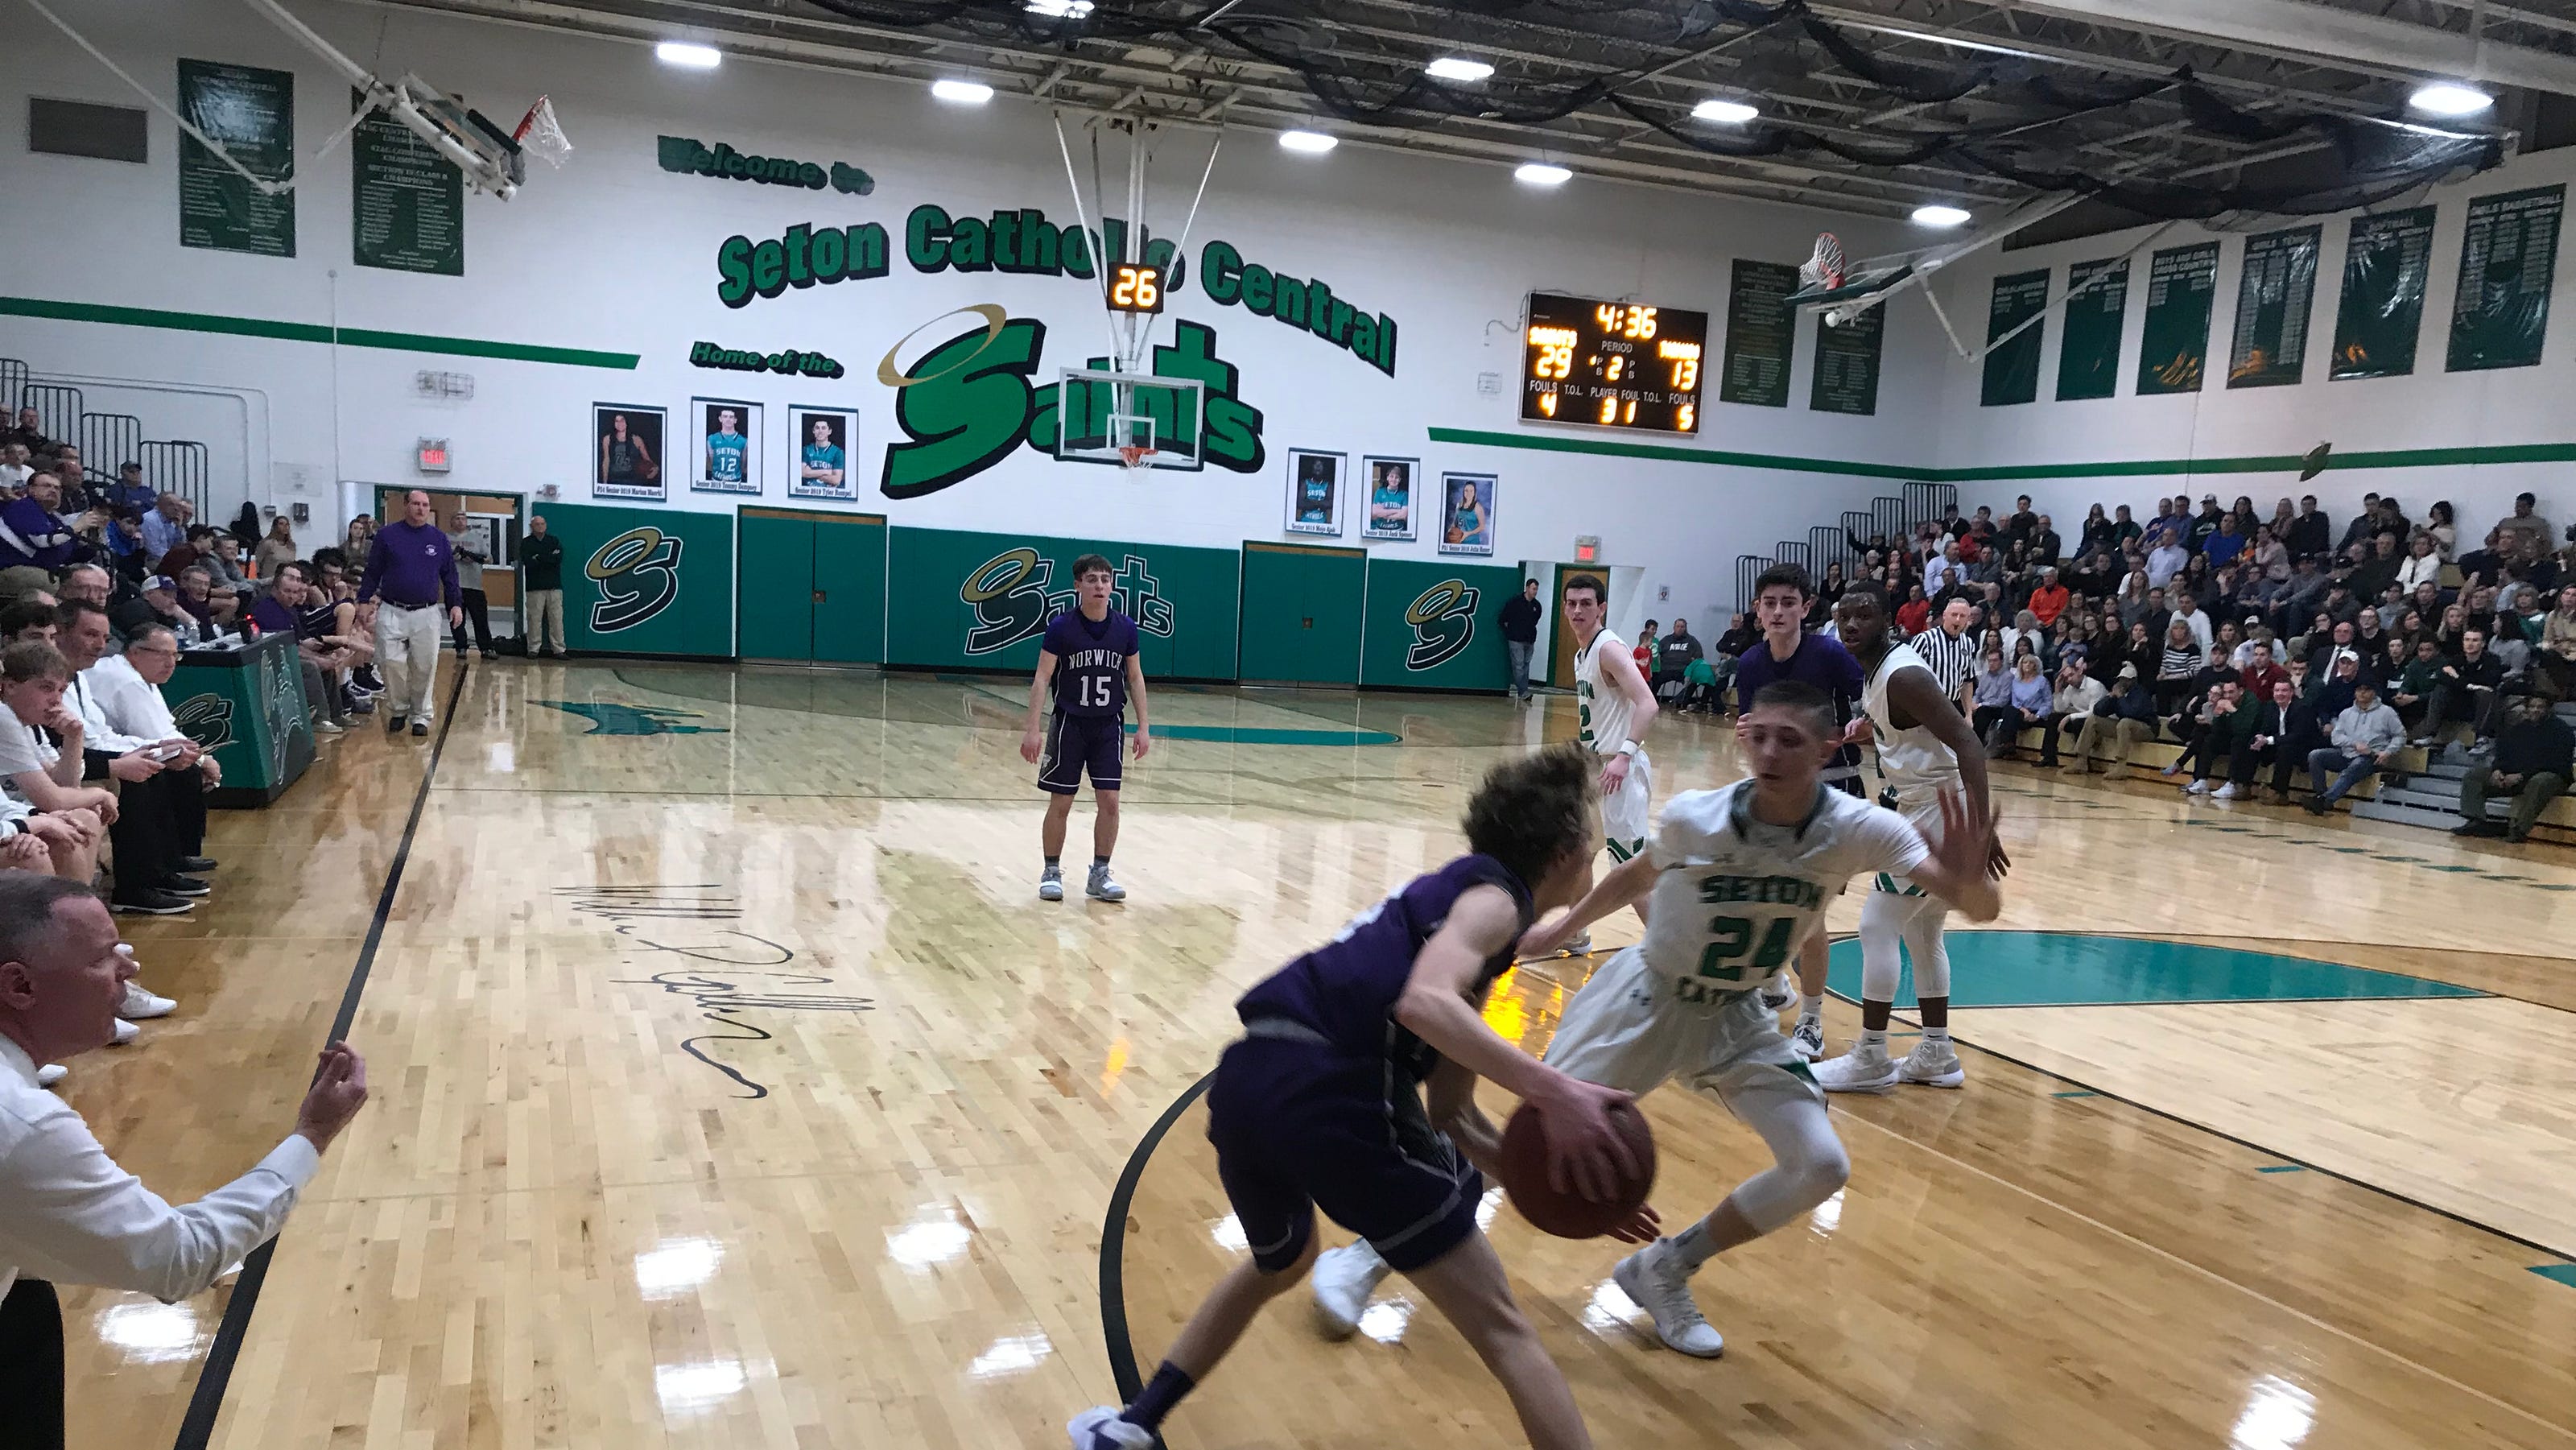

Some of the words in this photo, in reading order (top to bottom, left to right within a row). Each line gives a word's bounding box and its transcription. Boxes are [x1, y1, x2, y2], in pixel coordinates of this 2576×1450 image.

[658, 135, 828, 190] Welcome
[718, 222, 890, 308] Seton
[1200, 240, 1397, 378] Central
[1114, 267, 1158, 307] 26
[1597, 304, 1657, 338] 4:36
[689, 341, 768, 373] Home
[765, 349, 799, 376] of
[797, 351, 844, 379] the
[1536, 346, 1572, 378] 29
[1601, 340, 1633, 353] PERIOD
[1607, 355, 1624, 381] 2
[1673, 360, 1699, 390] 13
[1530, 379, 1558, 393] FOULS
[1590, 386, 1617, 399] PLAYER
[1621, 389, 1640, 401] FOUL
[1669, 392, 1695, 406] FOULS
[879, 317, 1265, 500] Saints
[1539, 393, 1557, 417] 4
[720, 456, 737, 472] 12
[1068, 648, 1123, 671] NORWICH
[1080, 675, 1112, 707] 15
[1699, 874, 1826, 912] SETON
